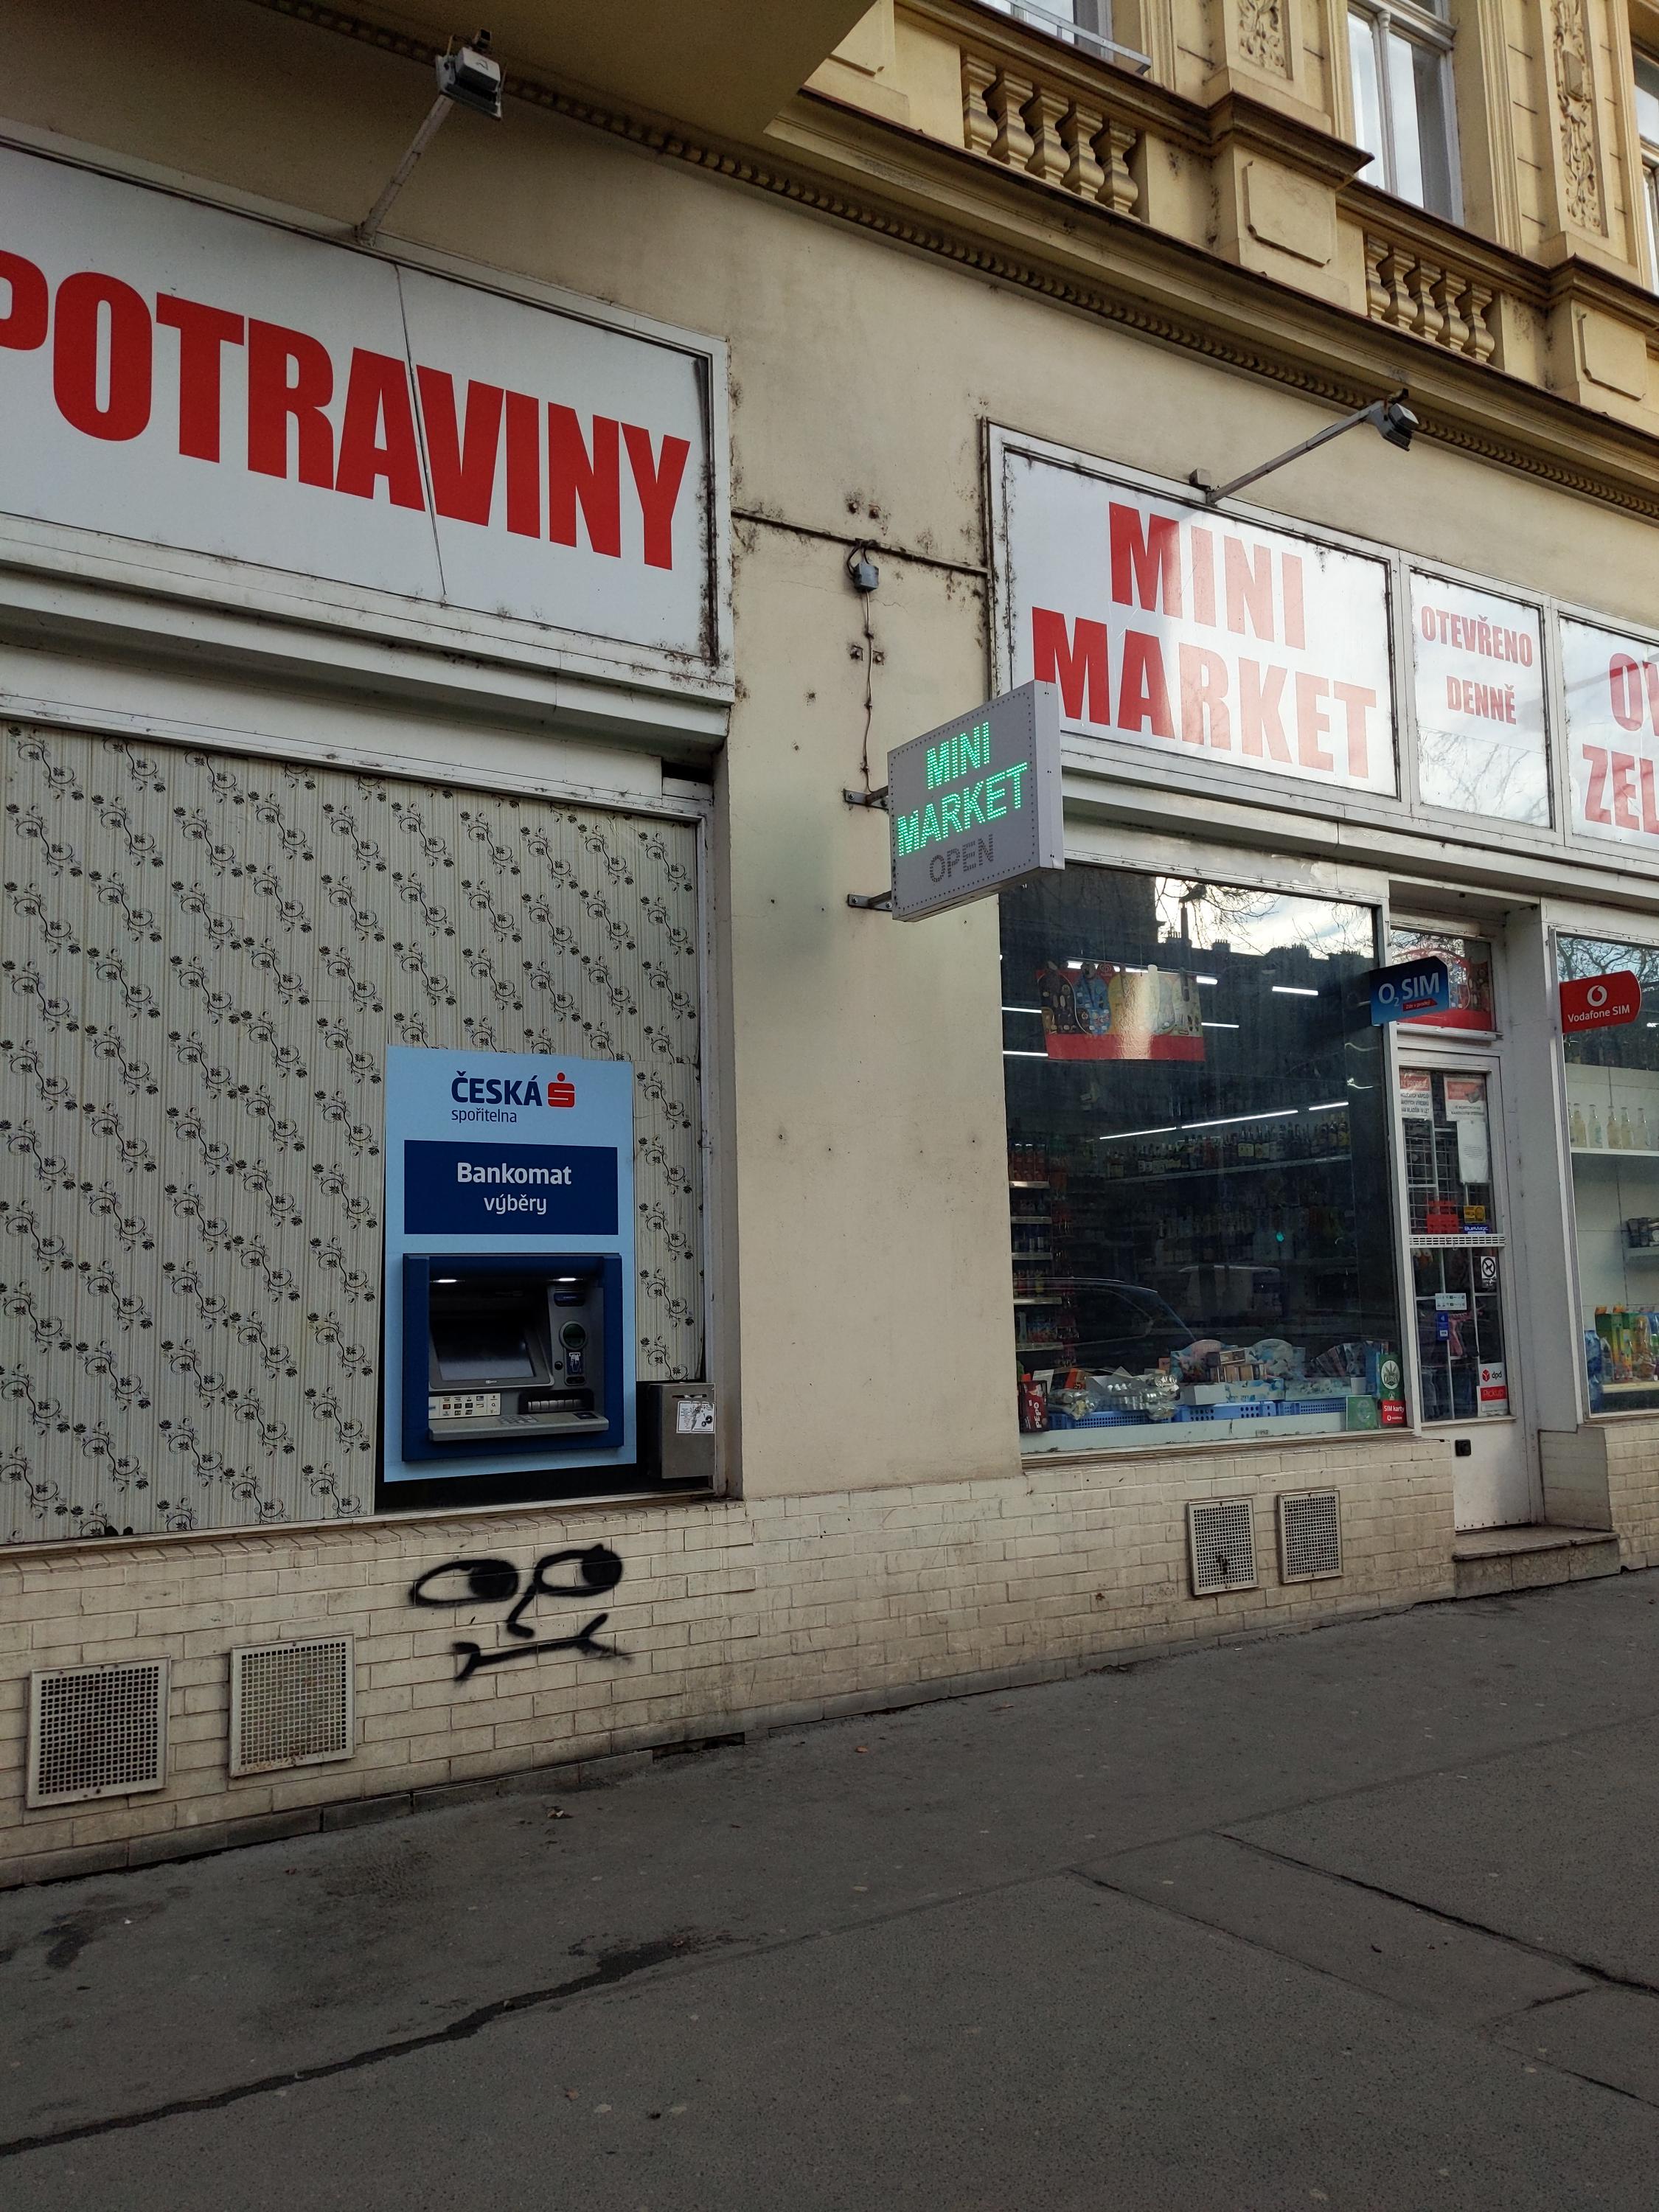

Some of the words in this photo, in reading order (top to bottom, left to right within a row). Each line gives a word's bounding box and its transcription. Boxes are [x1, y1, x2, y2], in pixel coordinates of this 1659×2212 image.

[1108, 501, 1306, 650] MINI
[1421, 605, 1532, 667] OTEVŘENO
[1032, 606, 1377, 779] MARKET
[1446, 675, 1517, 726] DENNĚ
[927, 721, 990, 790] MINI
[897, 762, 1028, 856] MARKET
[1582, 743, 1659, 835] ZEL
[929, 834, 994, 883] OPEN
[1401, 972, 1440, 1001] SIM
[1568, 1009, 1611, 1023] Vodafone
[1612, 1004, 1630, 1016] SIM
[451, 1070, 543, 1107] ČESKÁ
[451, 1107, 518, 1124] spořitelna
[457, 1162, 572, 1185] Bankomat
[484, 1193, 547, 1215] výběry
[1492, 1370, 1503, 1379] dpd
[1393, 1405, 1405, 1413] karty
